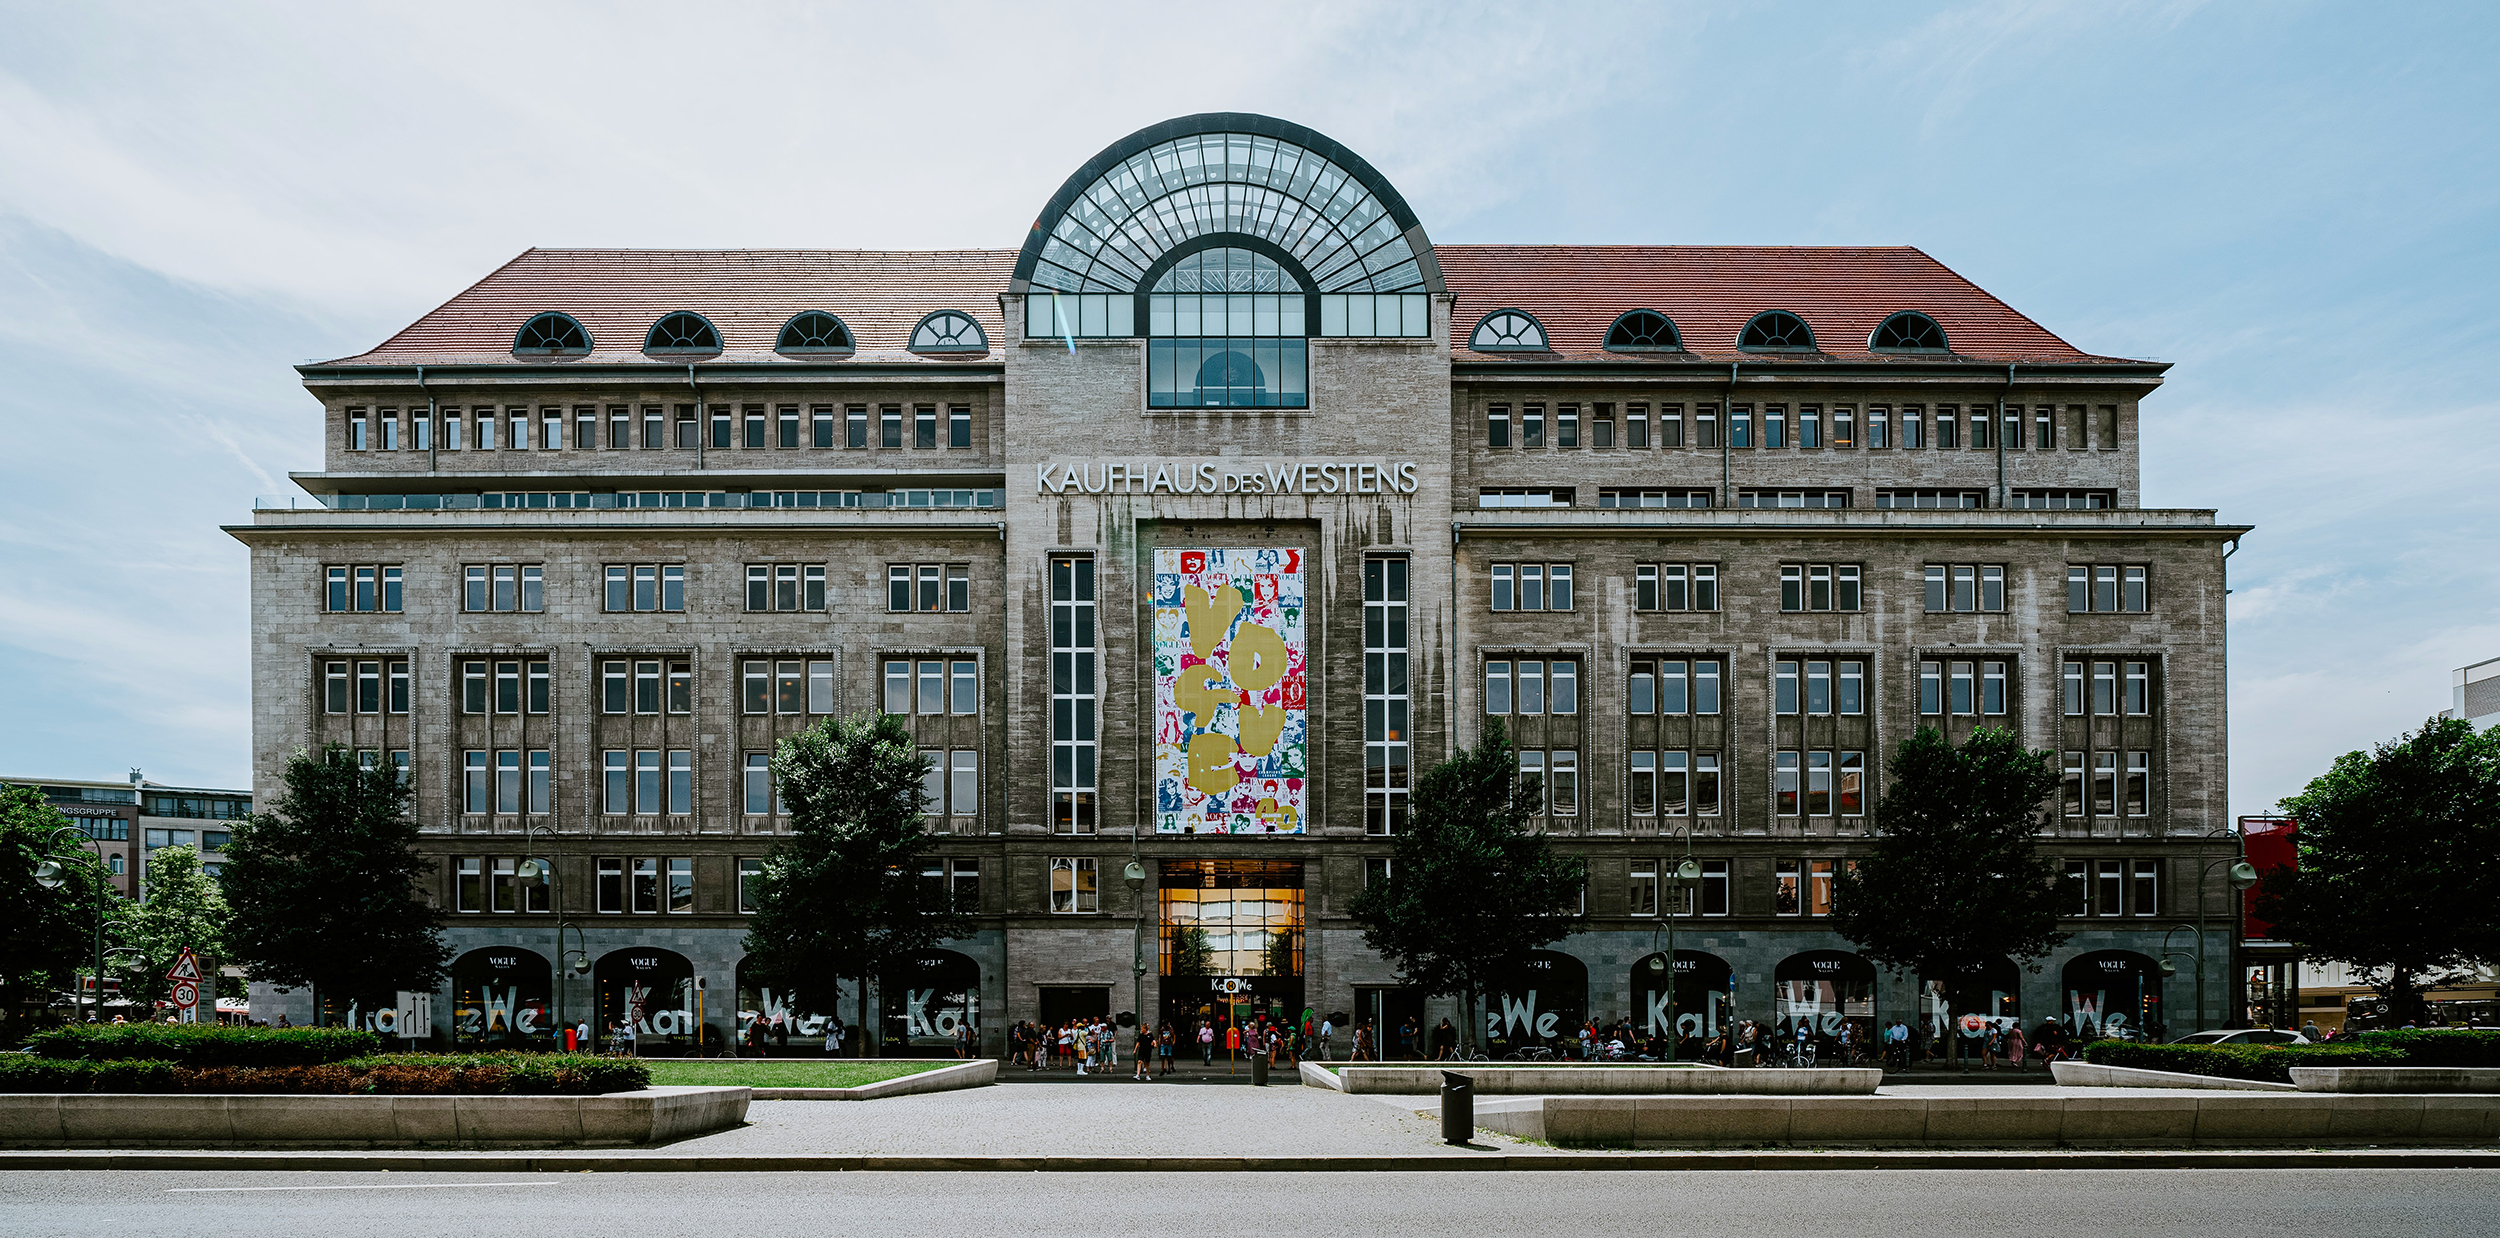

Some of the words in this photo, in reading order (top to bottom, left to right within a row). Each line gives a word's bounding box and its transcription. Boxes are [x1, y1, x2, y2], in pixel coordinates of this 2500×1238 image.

[1037, 462, 1217, 495] KAUFHAUS
[1224, 473, 1265, 493] DES
[1265, 462, 1418, 495] WESTENS
[489, 957, 517, 965] VOGUE
[631, 958, 658, 966] VOGUE
[1672, 961, 1696, 969] OGUE
[1812, 961, 1840, 970] VOGUE
[2098, 960, 2127, 969] VOGUE
[1211, 978, 1252, 991] KaWe
[178, 989, 194, 1001] 30
